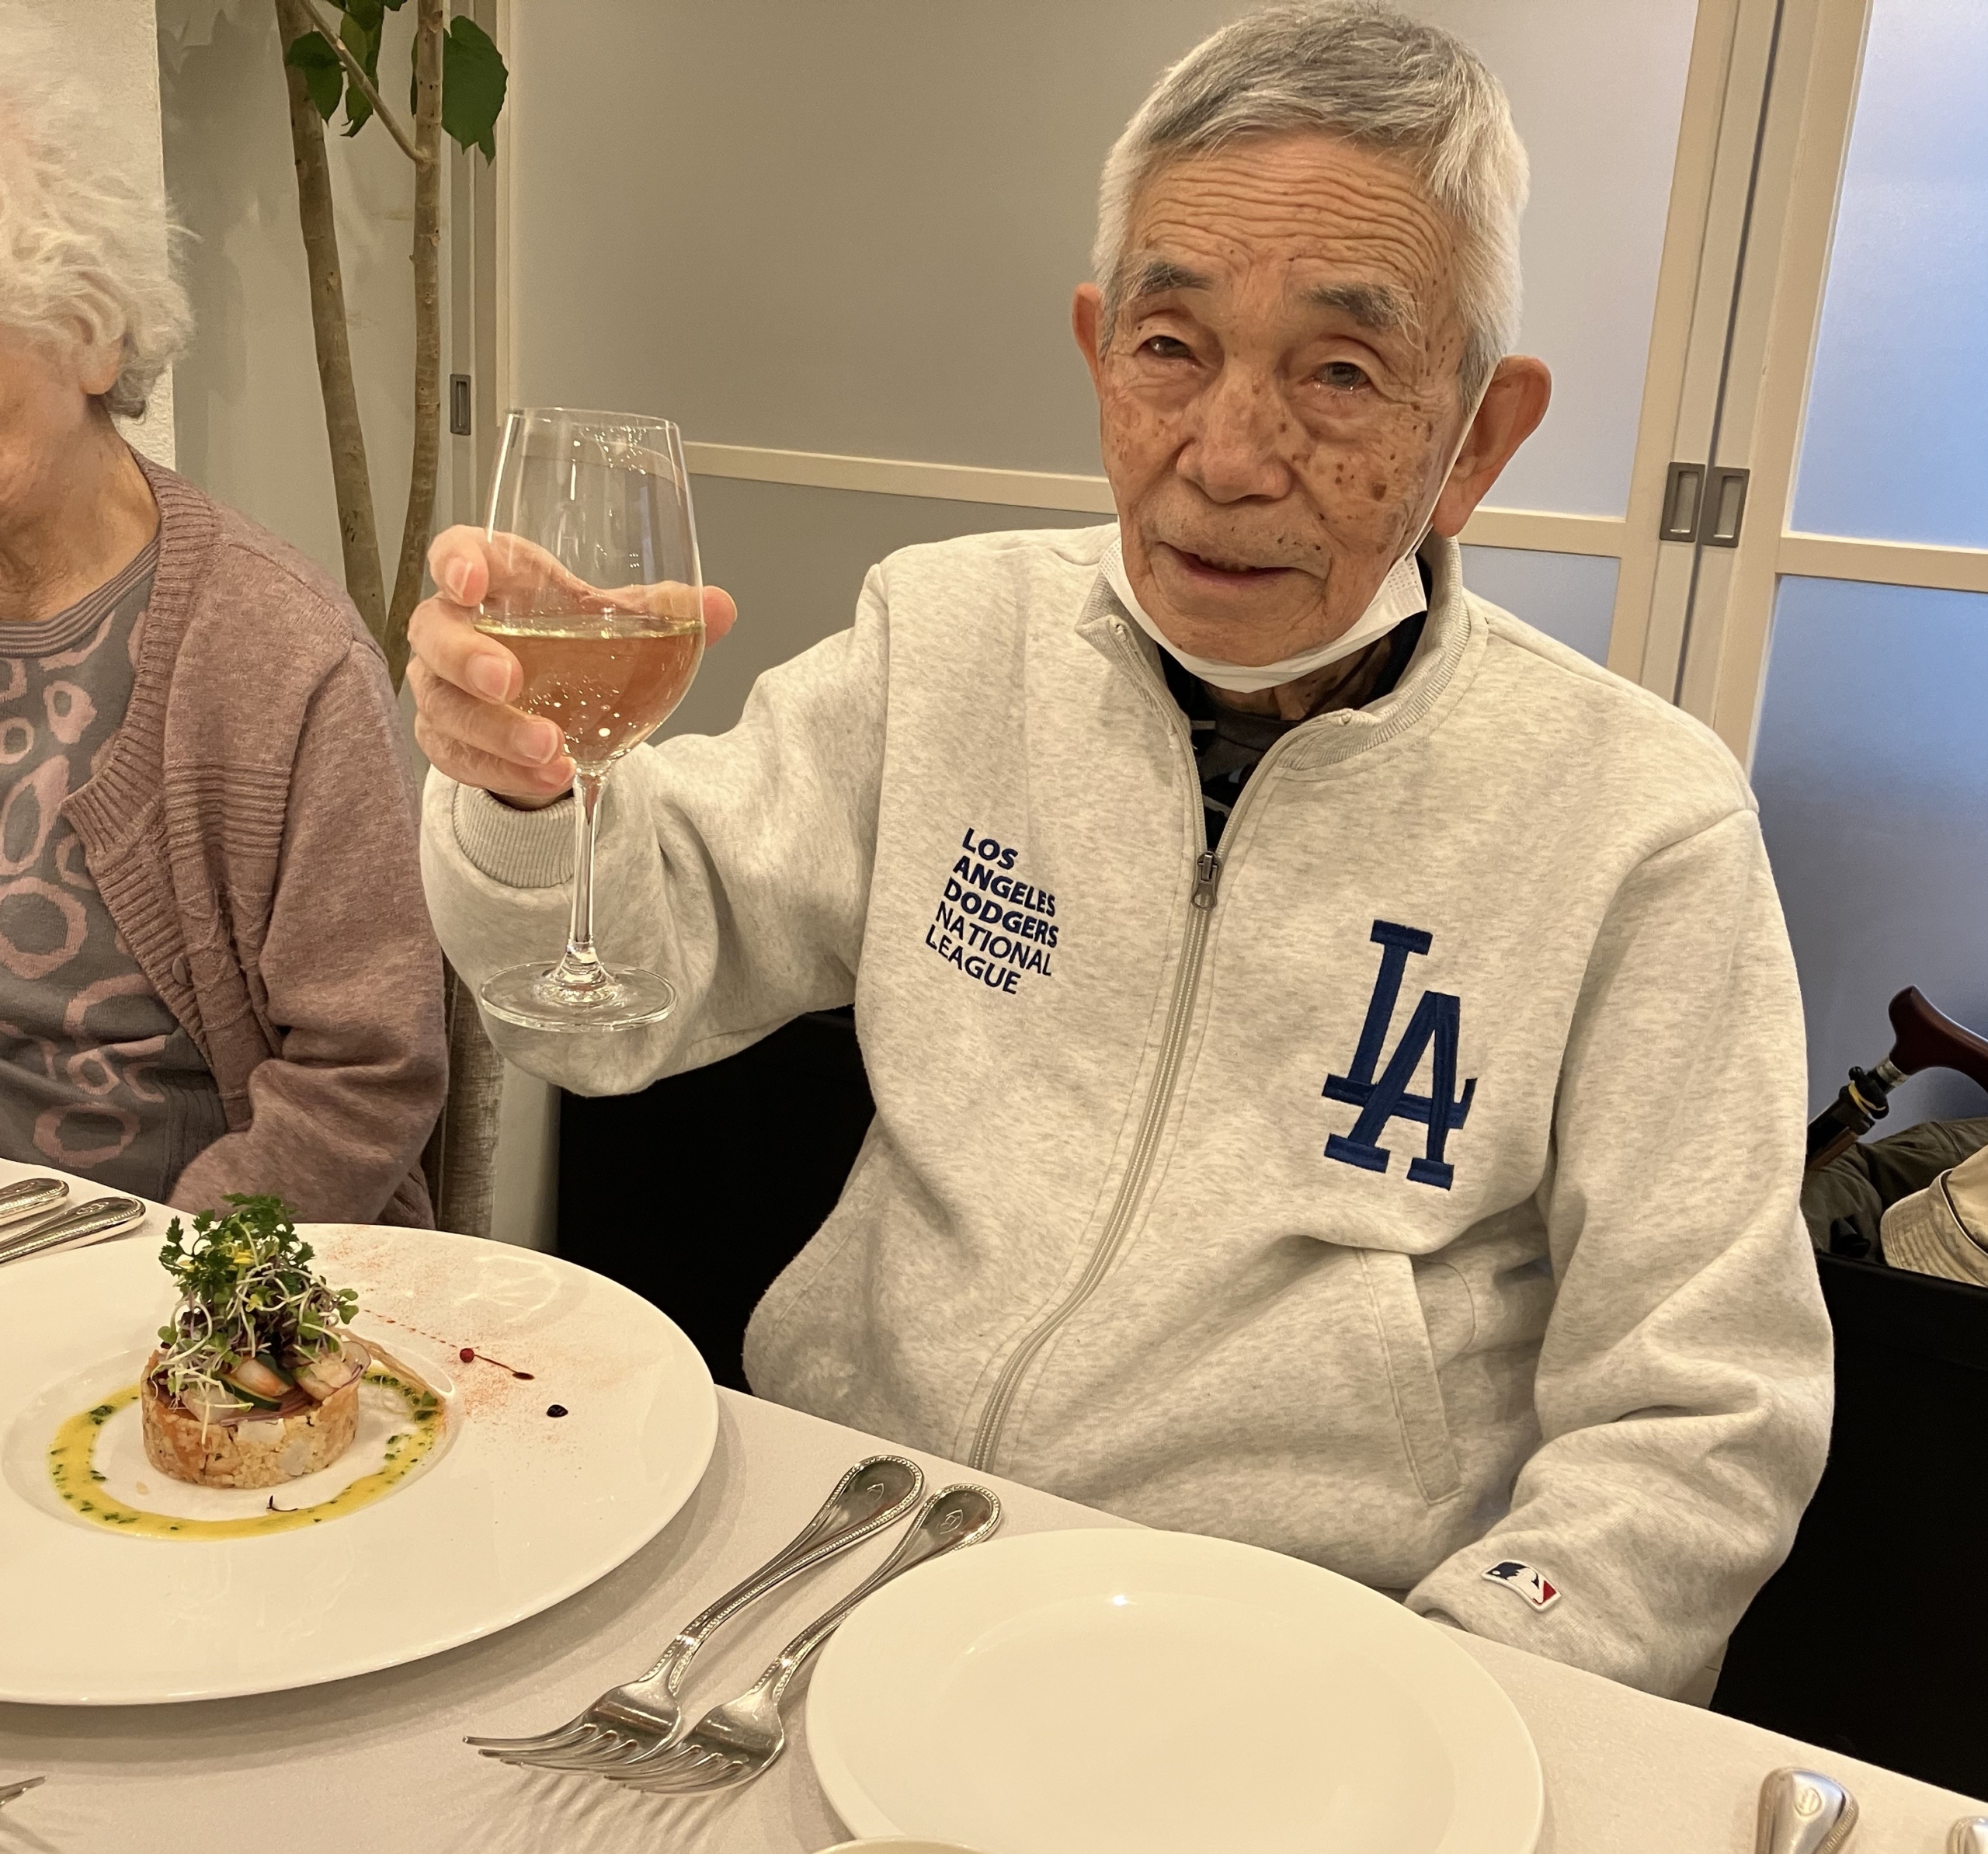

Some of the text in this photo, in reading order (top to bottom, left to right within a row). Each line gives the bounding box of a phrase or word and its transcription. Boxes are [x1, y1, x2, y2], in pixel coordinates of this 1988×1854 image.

[962, 827, 1019, 871] LOS
[944, 876, 1059, 948] DODGERS
[952, 855, 1055, 917] ANGELES
[925, 924, 1021, 995] LEAGUE
[935, 900, 1052, 977] NATIONAL
[1321, 919, 1478, 1191] LA
